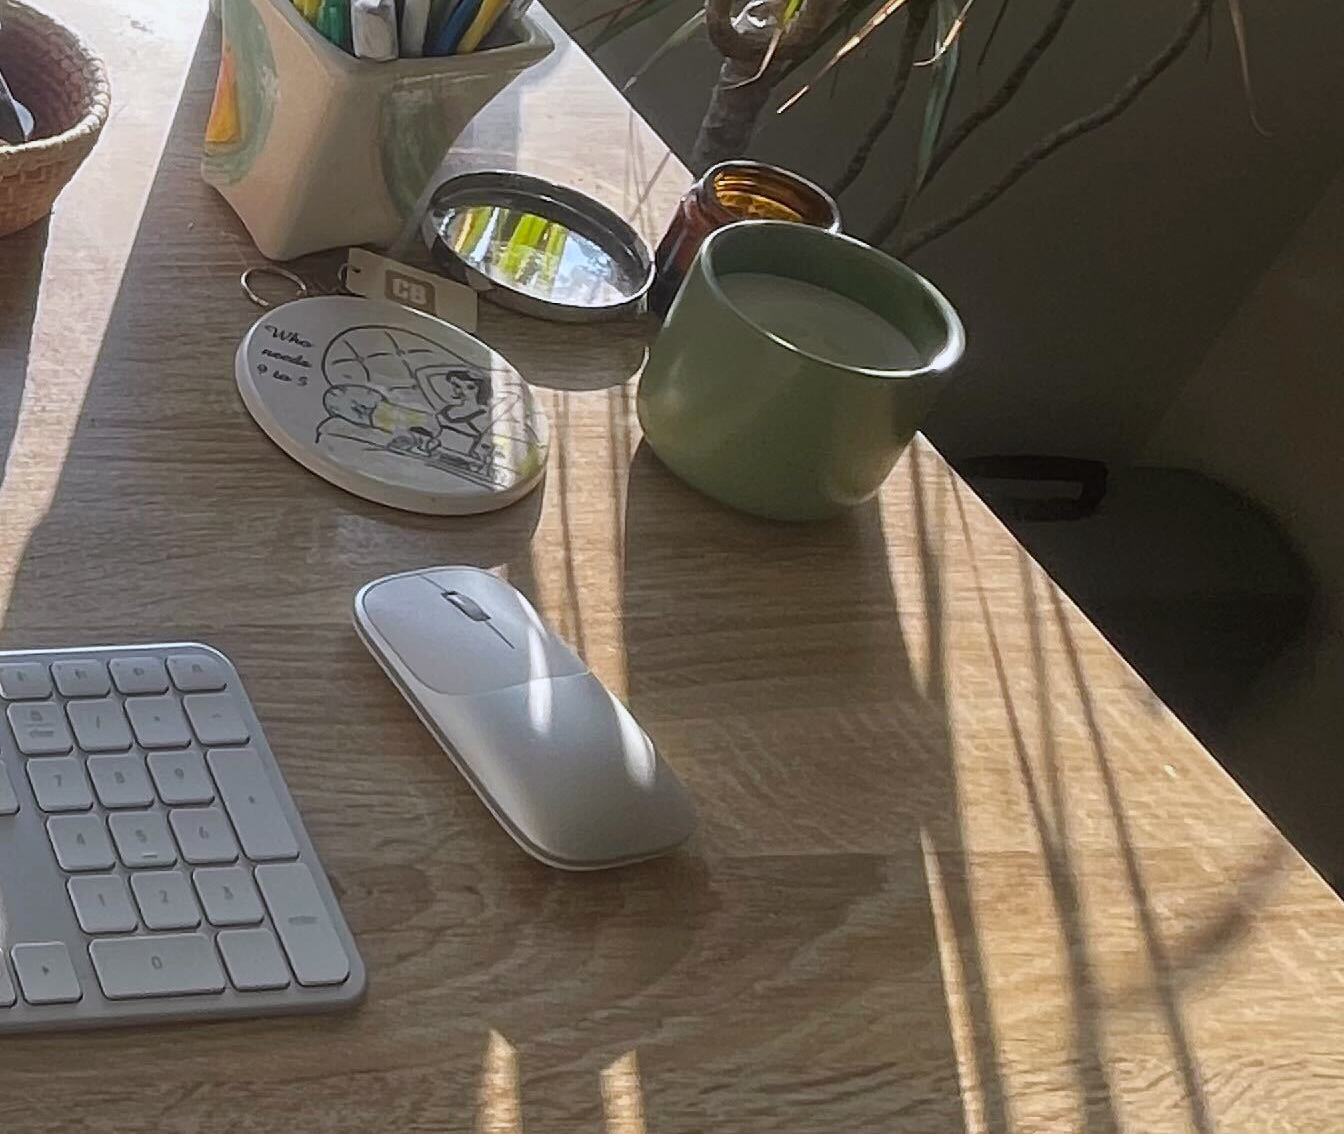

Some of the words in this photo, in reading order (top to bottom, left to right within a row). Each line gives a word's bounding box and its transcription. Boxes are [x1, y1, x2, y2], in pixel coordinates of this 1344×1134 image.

[265, 323, 313, 349] Who
[261, 349, 312, 368] needs
[273, 367, 292, 382] to
